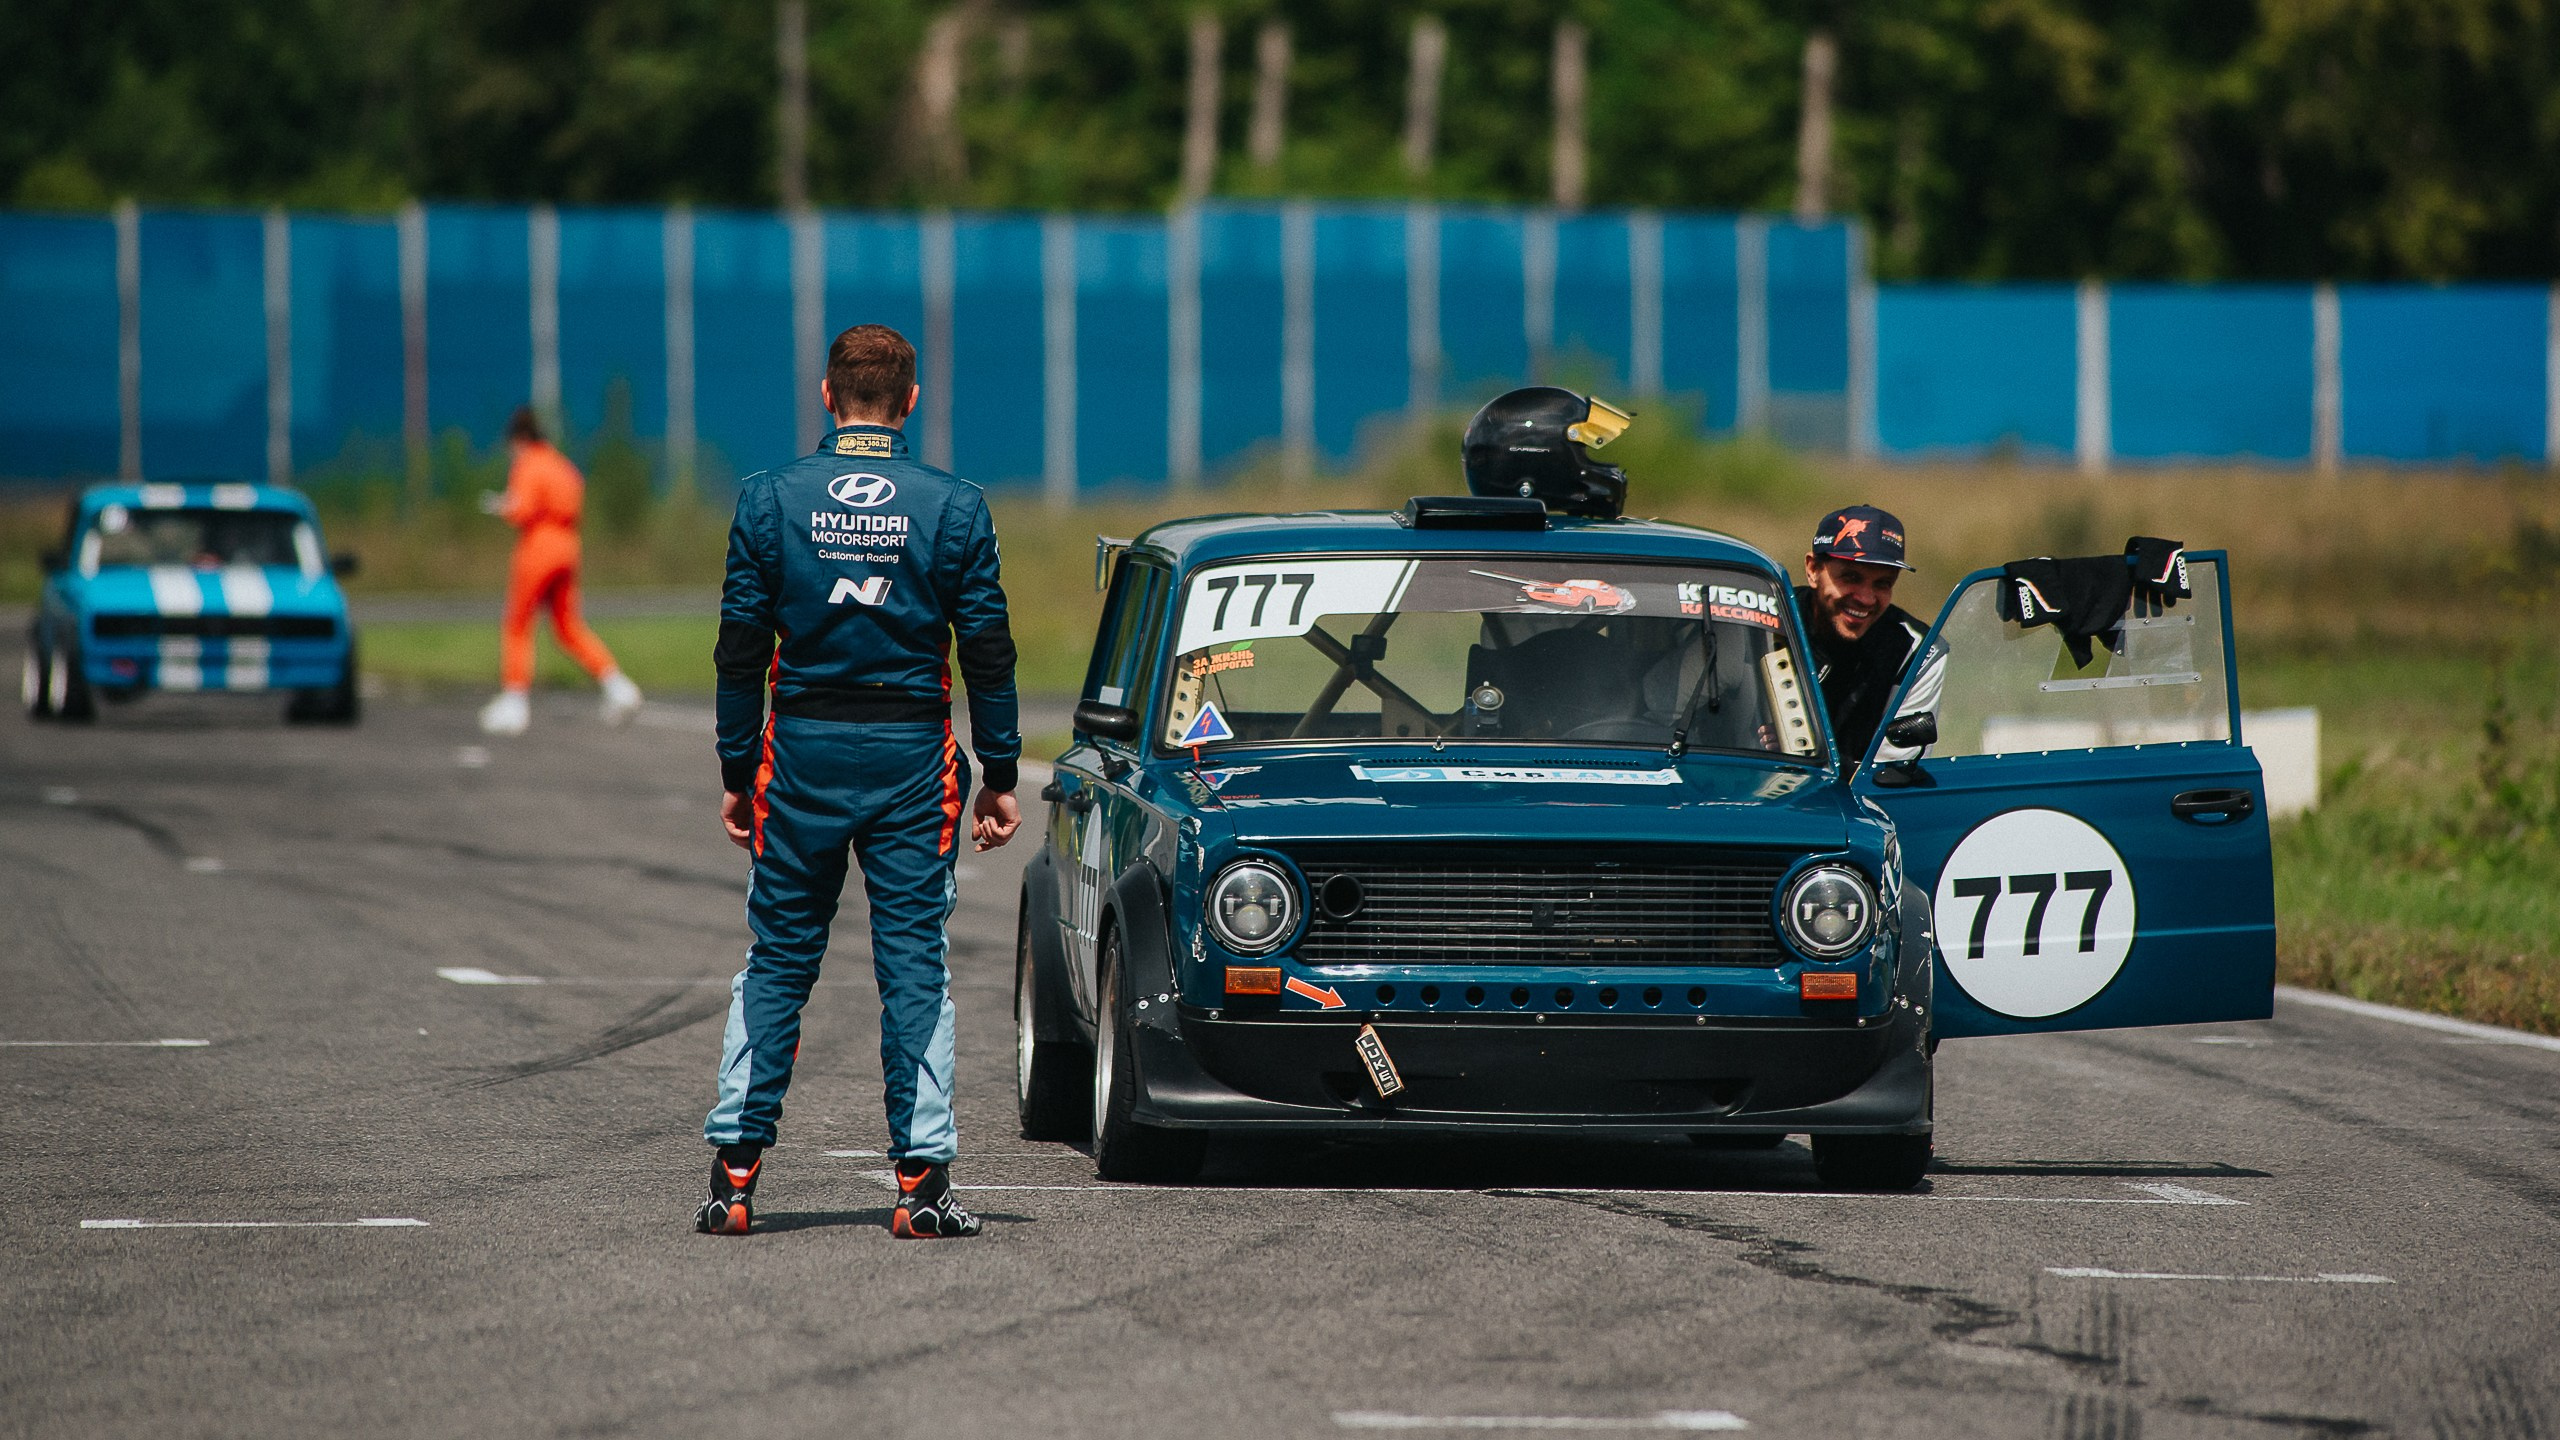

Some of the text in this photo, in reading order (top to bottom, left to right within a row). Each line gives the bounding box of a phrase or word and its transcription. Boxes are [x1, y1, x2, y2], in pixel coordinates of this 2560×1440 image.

[811, 511, 909, 532] HYUNDAI
[811, 530, 907, 547] MOTORSPORT
[818, 549, 899, 563] Customer Racing
[1207, 573, 1315, 632] 777
[1193, 650, 1255, 669] ЗА ЖИЗНЬ
[1193, 658, 1255, 676] НА ДОРОГАХ
[1953, 869, 2113, 960] 777
